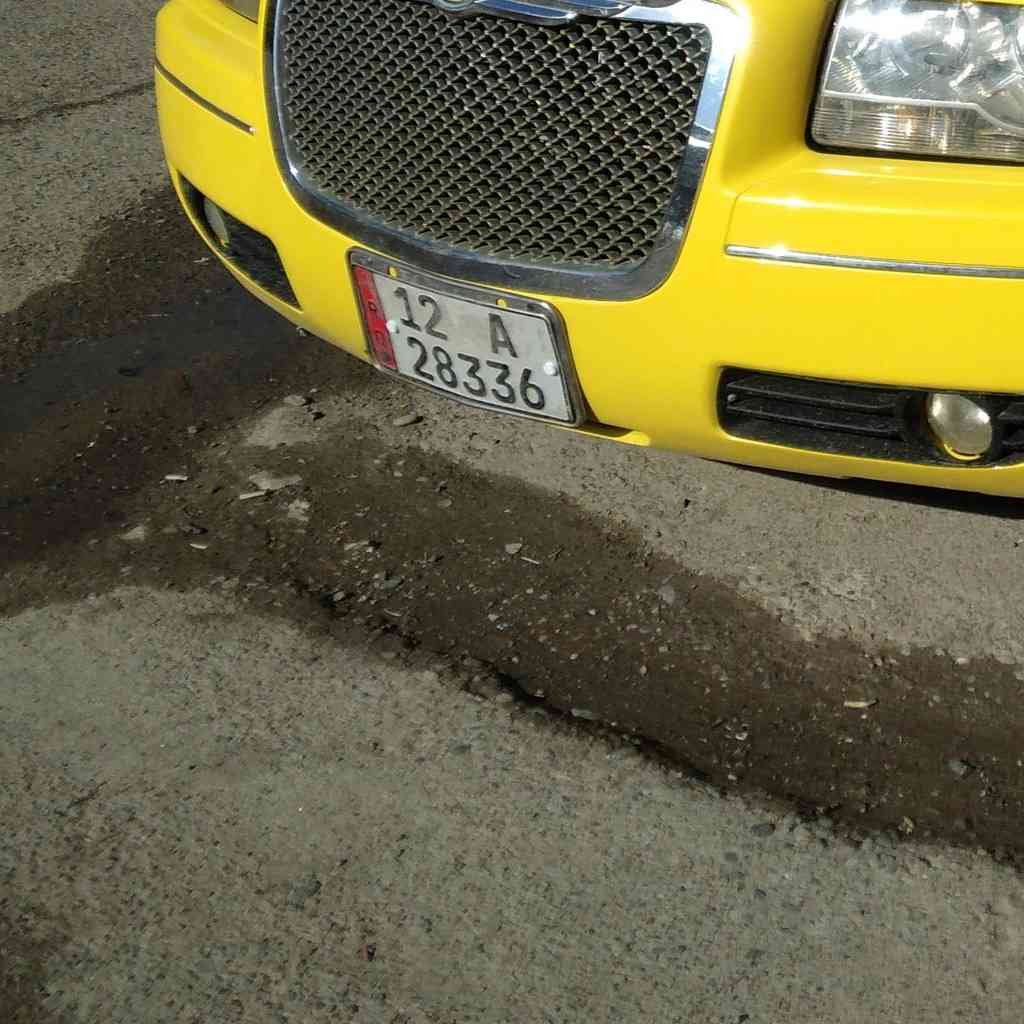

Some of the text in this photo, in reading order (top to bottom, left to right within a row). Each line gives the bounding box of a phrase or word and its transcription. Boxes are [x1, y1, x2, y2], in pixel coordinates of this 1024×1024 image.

[394, 286, 448, 340] 12
[487, 312, 518, 358] A
[407, 336, 545, 410] 28336
